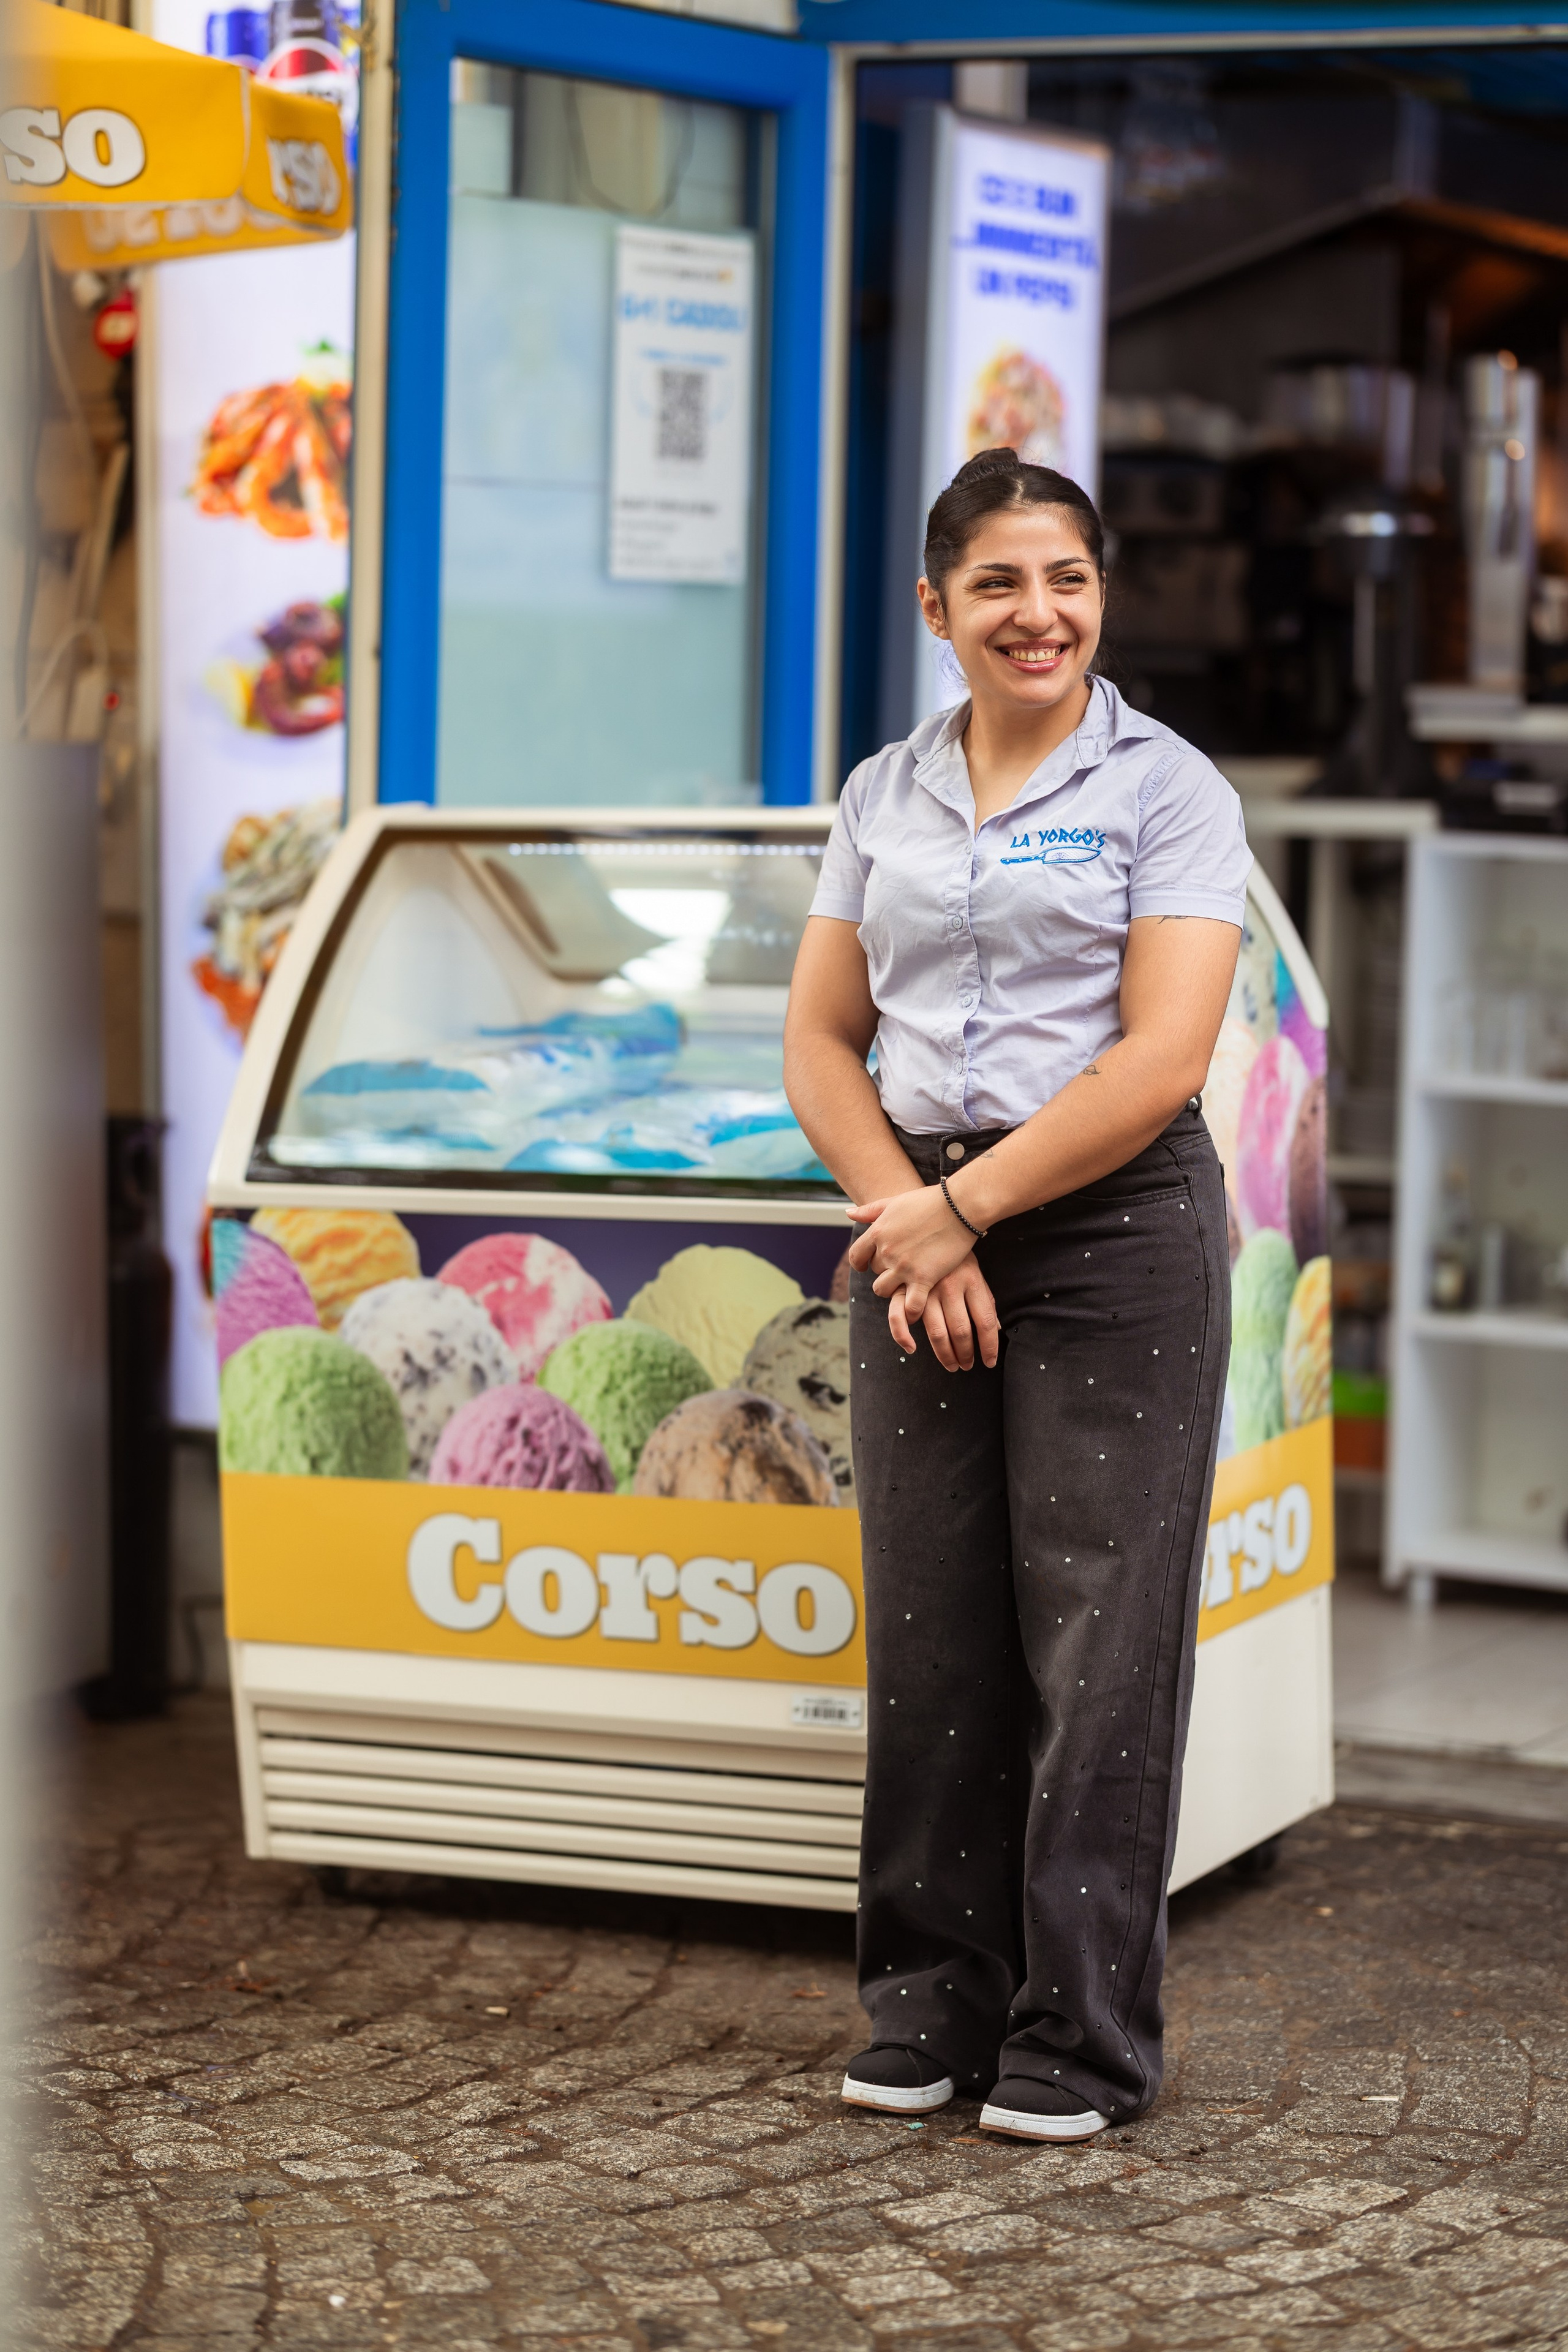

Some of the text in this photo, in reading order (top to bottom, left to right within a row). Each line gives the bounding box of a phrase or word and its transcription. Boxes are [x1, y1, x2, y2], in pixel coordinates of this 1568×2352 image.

[1011, 827, 1106, 848] LA YORGO'S
[407, 1512, 856, 1656] Corso
[1199, 1482, 1311, 1612] rso
